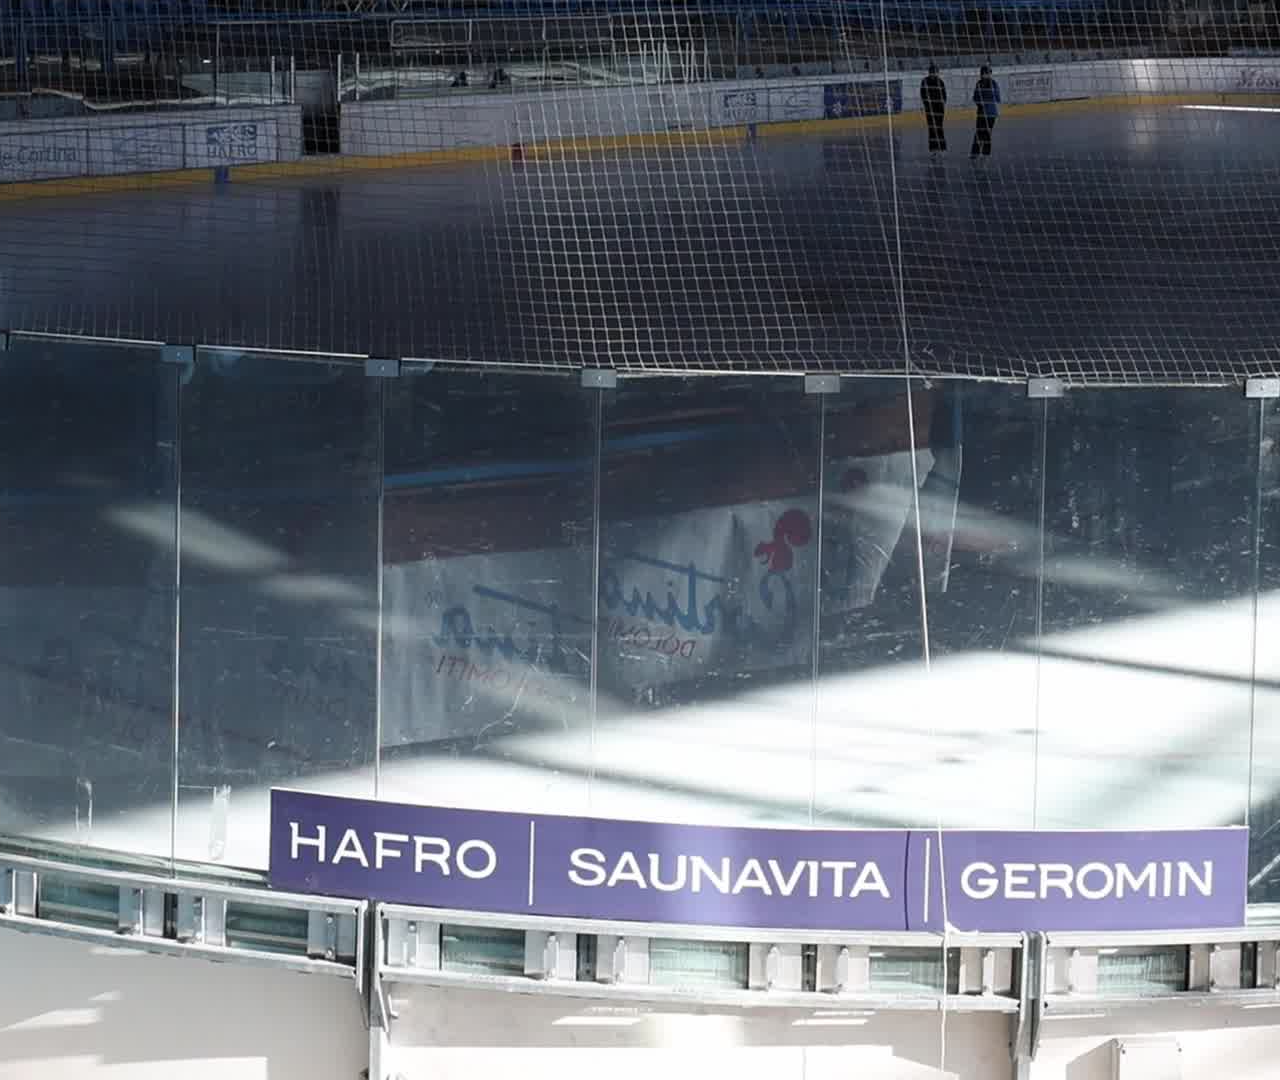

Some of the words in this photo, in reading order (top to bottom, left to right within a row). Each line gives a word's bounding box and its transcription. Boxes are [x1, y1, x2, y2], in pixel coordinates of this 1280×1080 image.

[289, 821, 498, 880] HAFRO
[567, 847, 891, 900] SAUNAVITA
[959, 859, 1214, 902] GEROMIN
